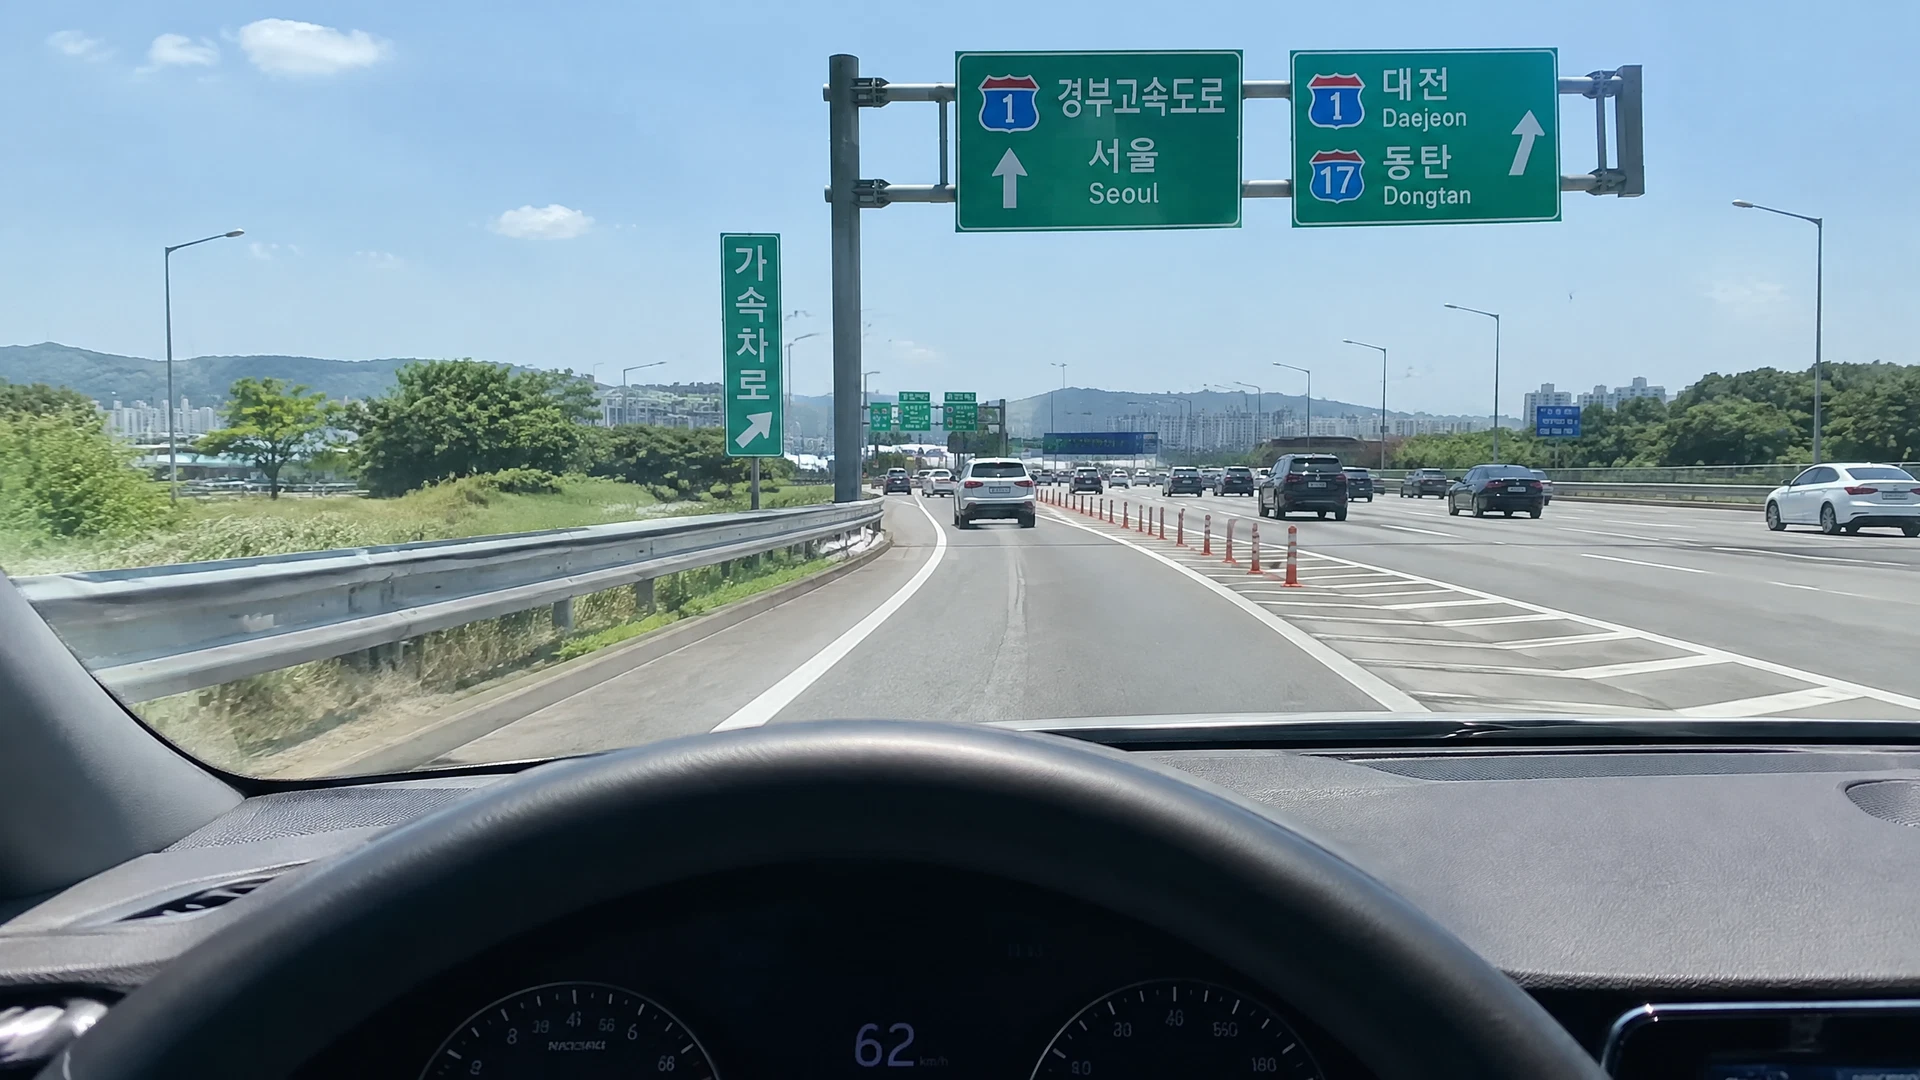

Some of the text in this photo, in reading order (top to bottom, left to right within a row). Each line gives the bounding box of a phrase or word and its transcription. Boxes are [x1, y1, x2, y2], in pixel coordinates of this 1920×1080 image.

[1057, 77, 1226, 117] 경부고속도로
[1383, 67, 1447, 101] 대전
[1001, 93, 1017, 123] 1
[1329, 90, 1344, 120] 1
[1383, 107, 1467, 129] Daejeon
[1088, 137, 1159, 173] 서울
[1383, 144, 1453, 180] 동탄
[1088, 182, 1159, 204] Seoul
[1319, 165, 1354, 195] 17
[1383, 186, 1472, 208] Dongtan
[735, 245, 771, 401] 가속차로
[854, 1021, 915, 1068] 62
